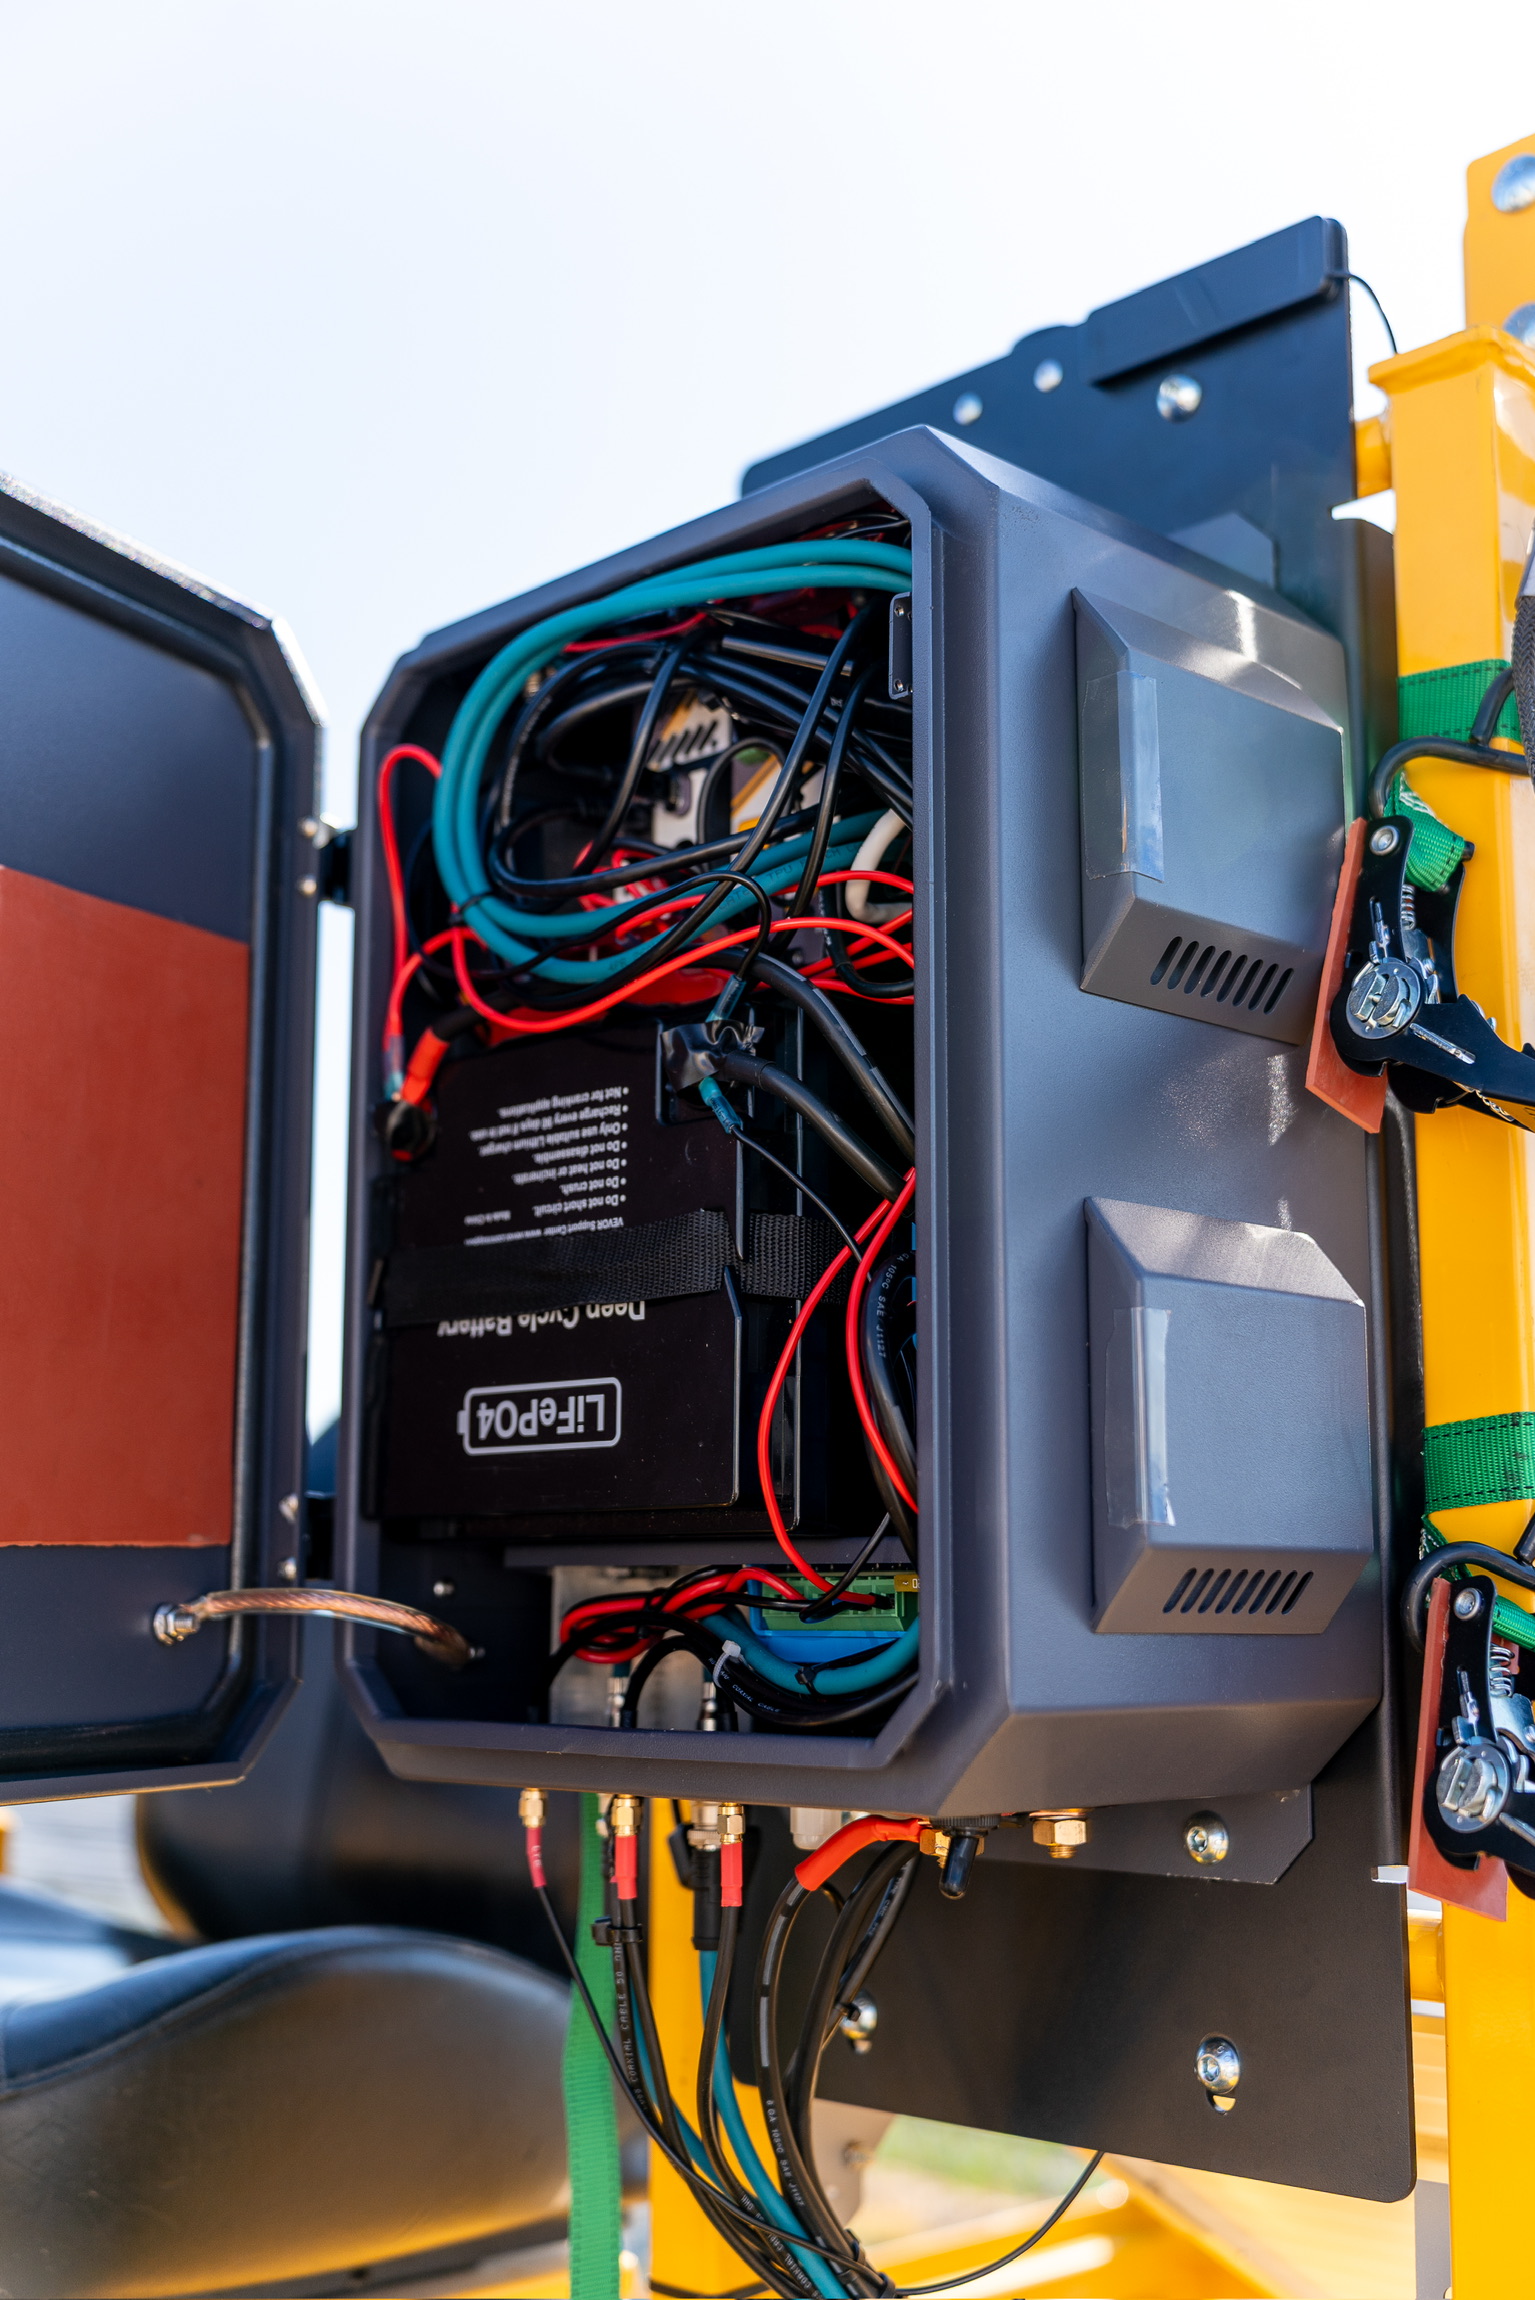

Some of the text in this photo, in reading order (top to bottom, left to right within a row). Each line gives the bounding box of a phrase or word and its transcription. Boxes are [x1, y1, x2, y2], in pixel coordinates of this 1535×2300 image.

[554, 1112, 578, 1124] every
[579, 1104, 621, 1121] Recharge
[582, 1126, 598, 1137] use
[600, 1121, 620, 1134] Only
[546, 1129, 580, 1146] suitable
[590, 1143, 605, 1155] not
[607, 1140, 620, 1152] Do
[569, 1164, 588, 1176] heat
[589, 1160, 605, 1172] not
[606, 1158, 620, 1170] Do
[558, 1167, 567, 1178] or
[589, 1179, 604, 1191] not
[606, 1176, 619, 1188] Do
[564, 1199, 587, 1212] short
[589, 1196, 604, 1209] not
[605, 1194, 619, 1206] Do
[543, 1224, 566, 1236] Center
[568, 1220, 596, 1233] Support
[596, 1217, 624, 1230] VEVOR
[876, 1295, 886, 1317] SAE
[876, 1324, 886, 1358] J1127
[476, 1393, 606, 1441] LiFePO4
[616, 1971, 624, 1984] 50
[617, 1994, 629, 2030] CABLE
[623, 2038, 638, 2082] COAXIAL
[767, 2108, 776, 2122] GA
[779, 2159, 792, 2178] SAE
